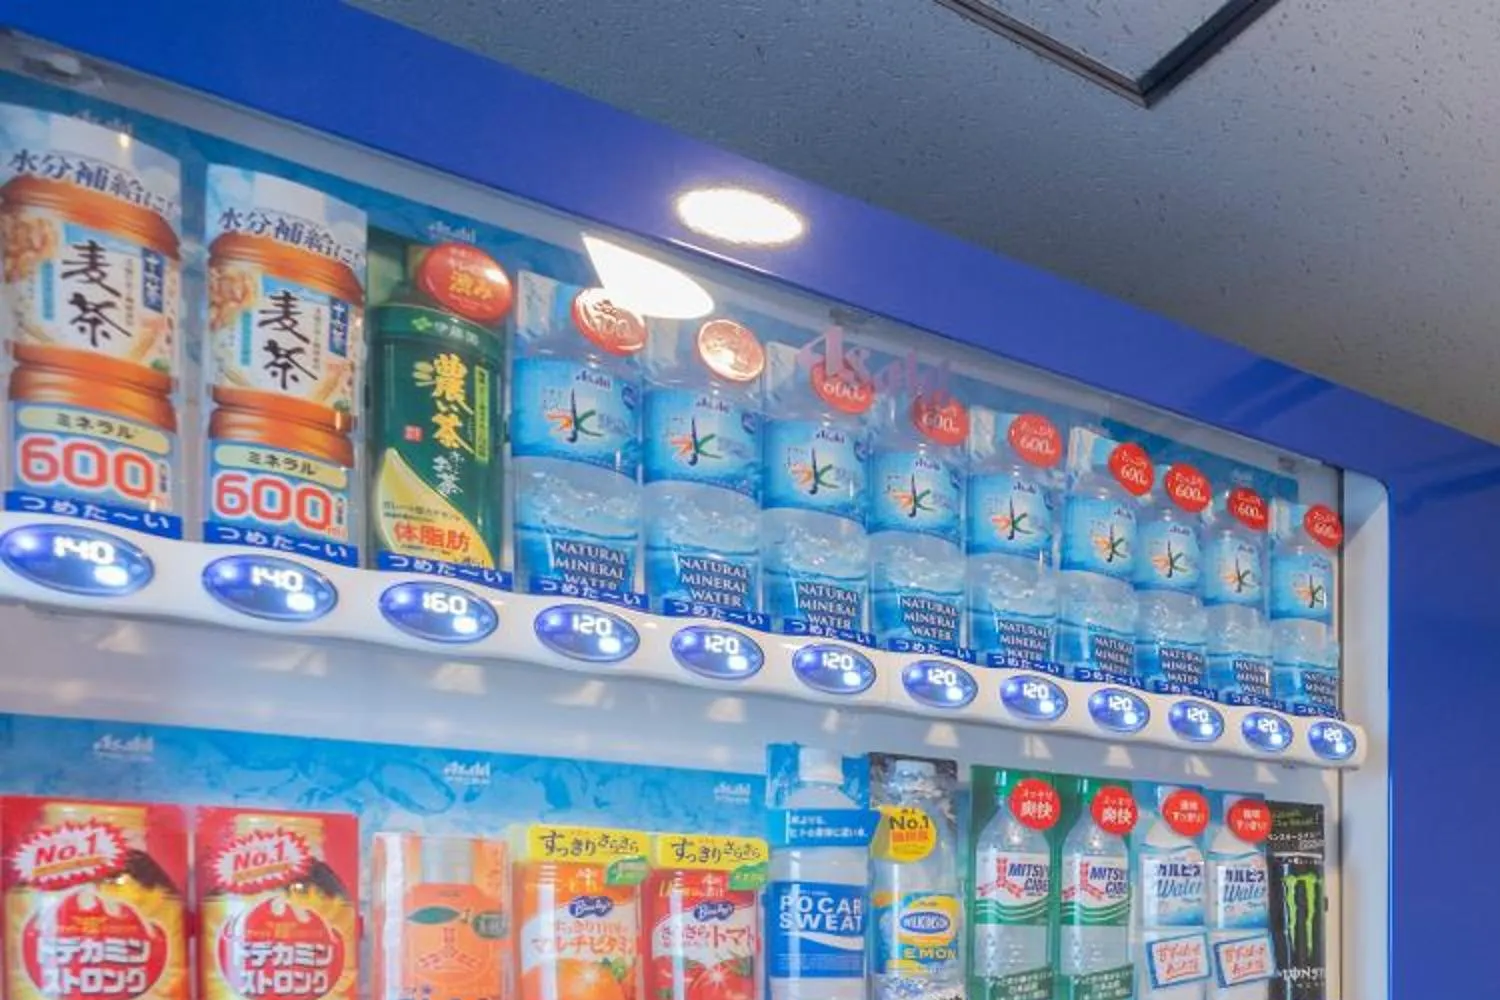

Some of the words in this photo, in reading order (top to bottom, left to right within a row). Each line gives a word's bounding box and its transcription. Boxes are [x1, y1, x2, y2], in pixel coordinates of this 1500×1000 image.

[61, 239, 132, 347] 麦茶
[258, 290, 318, 390] 麦茶
[56, 412, 135, 439] ミネラル
[19, 435, 153, 500] 600
[248, 452, 318, 476] ミネラル
[216, 473, 332, 531] 600
[54, 536, 116, 565] 140
[553, 541, 626, 564] NATURAL
[252, 566, 304, 592] 140
[554, 558, 625, 581] MINERAL
[680, 557, 748, 578] NATURAL
[681, 573, 748, 594] MINERAL
[800, 584, 857, 602] NATURAL
[422, 591, 467, 615] 160
[691, 589, 742, 607] WATER
[800, 600, 856, 616] MINERAL
[902, 598, 958, 616] NATURAL
[572, 614, 612, 636] 120
[808, 614, 851, 629] WATER
[904, 612, 955, 628] MINERAL
[704, 635, 741, 654] 120
[912, 626, 952, 640] WATER
[822, 652, 853, 670] 120
[928, 669, 956, 686] 120
[1023, 683, 1049, 699] 120
[889, 816, 930, 830] No.1
[35, 834, 97, 865] No.1
[233, 841, 288, 869] No.1
[539, 832, 596, 857] すっきり
[671, 839, 721, 863] すっきり
[780, 913, 862, 931] SWEAT
[37, 940, 148, 965] ドデカミン
[233, 942, 333, 967] ドデカミン
[900, 945, 956, 961] EMON
[42, 969, 146, 994] ストロング
[240, 970, 329, 994] ストロング
